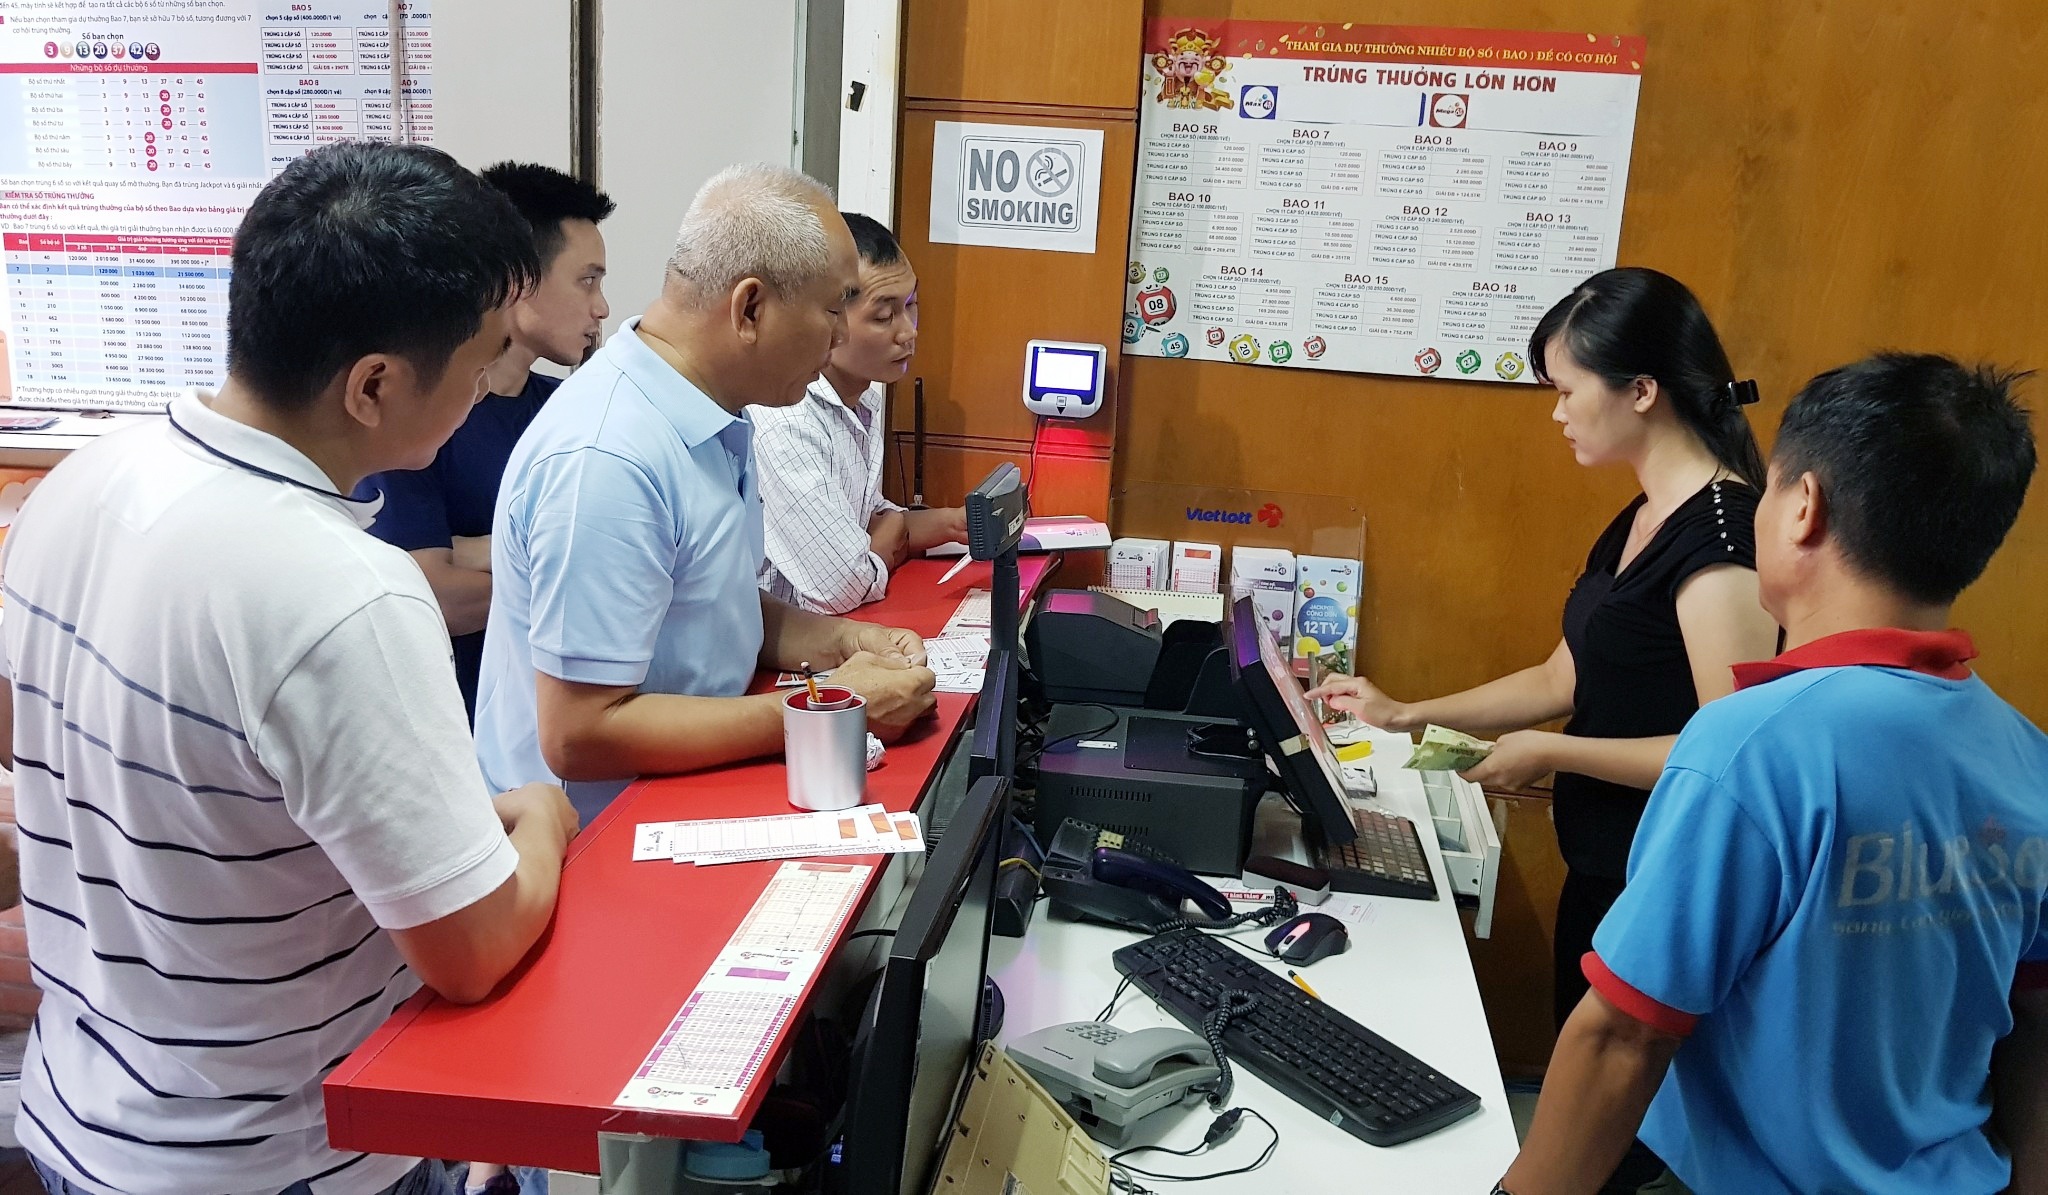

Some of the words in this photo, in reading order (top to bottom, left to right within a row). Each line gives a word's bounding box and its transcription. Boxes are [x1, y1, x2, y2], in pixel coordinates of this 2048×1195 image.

[92, 33, 106, 41] bạn
[107, 33, 124, 42] chọn
[47, 46, 54, 55] 3
[65, 46, 70, 55] 9
[78, 45, 89, 55] 13
[94, 45, 106, 55] 20
[112, 46, 123, 55] 37
[130, 45, 142, 55] 42
[146, 45, 158, 54] 45
[1286, 41, 1320, 51] THAM
[1322, 42, 1342, 52] GIA
[1344, 43, 1363, 55] DỰ
[1364, 41, 1415, 55] THƯỞNG
[1457, 46, 1475, 61] BỘ
[1477, 46, 1493, 58] SỐ
[1502, 50, 1528, 61] BAO
[1555, 50, 1573, 62] CÓ
[1575, 52, 1594, 63] CƠ
[1594, 52, 1618, 66] HỘI
[1303, 64, 1368, 84] TRÚNG
[1376, 66, 1457, 87] THƯỞNG
[1465, 70, 1505, 90] LỚN
[1512, 75, 1557, 93] HƠN
[1173, 123, 1199, 133] BAO
[1202, 125, 1218, 134] 5R
[1292, 128, 1320, 139] BAO
[1323, 130, 1330, 140] 7
[1414, 134, 1442, 145] BAO
[1445, 136, 1452, 146] 8
[1538, 141, 1567, 151] BAO
[1570, 142, 1577, 152] 9
[968, 148, 1020, 193] NO
[5, 190, 20, 199] KIỂM
[34, 191, 43, 199] SỐ
[43, 191, 66, 199] TRÚNG
[66, 192, 95, 200] THƯỞNG
[1168, 192, 1195, 202] BAO
[1198, 194, 1211, 203] 10
[1283, 198, 1310, 209] BAO
[1313, 200, 1325, 210] 11
[966, 198, 1074, 225] SMOKING
[1403, 205, 1430, 216] BAO
[1434, 207, 1448, 217] 12
[1526, 212, 1554, 223] BAO
[1558, 214, 1571, 224] 13
[1220, 265, 1247, 276] BAO
[1250, 267, 1264, 277] 14
[1344, 273, 1371, 284] BAO
[1375, 275, 1389, 285] 15
[1472, 281, 1500, 292] BAO
[1503, 283, 1517, 293] 18
[1148, 298, 1164, 311] 08
[1125, 322, 1135, 335] 45
[1169, 341, 1181, 350] 45
[1239, 343, 1250, 357] 20
[1275, 347, 1285, 356] 27
[1310, 342, 1319, 350] 08
[1422, 355, 1433, 365] 08
[1463, 357, 1473, 366] 27
[1504, 361, 1516, 371] 20
[1185, 506, 1252, 525] Vietlott
